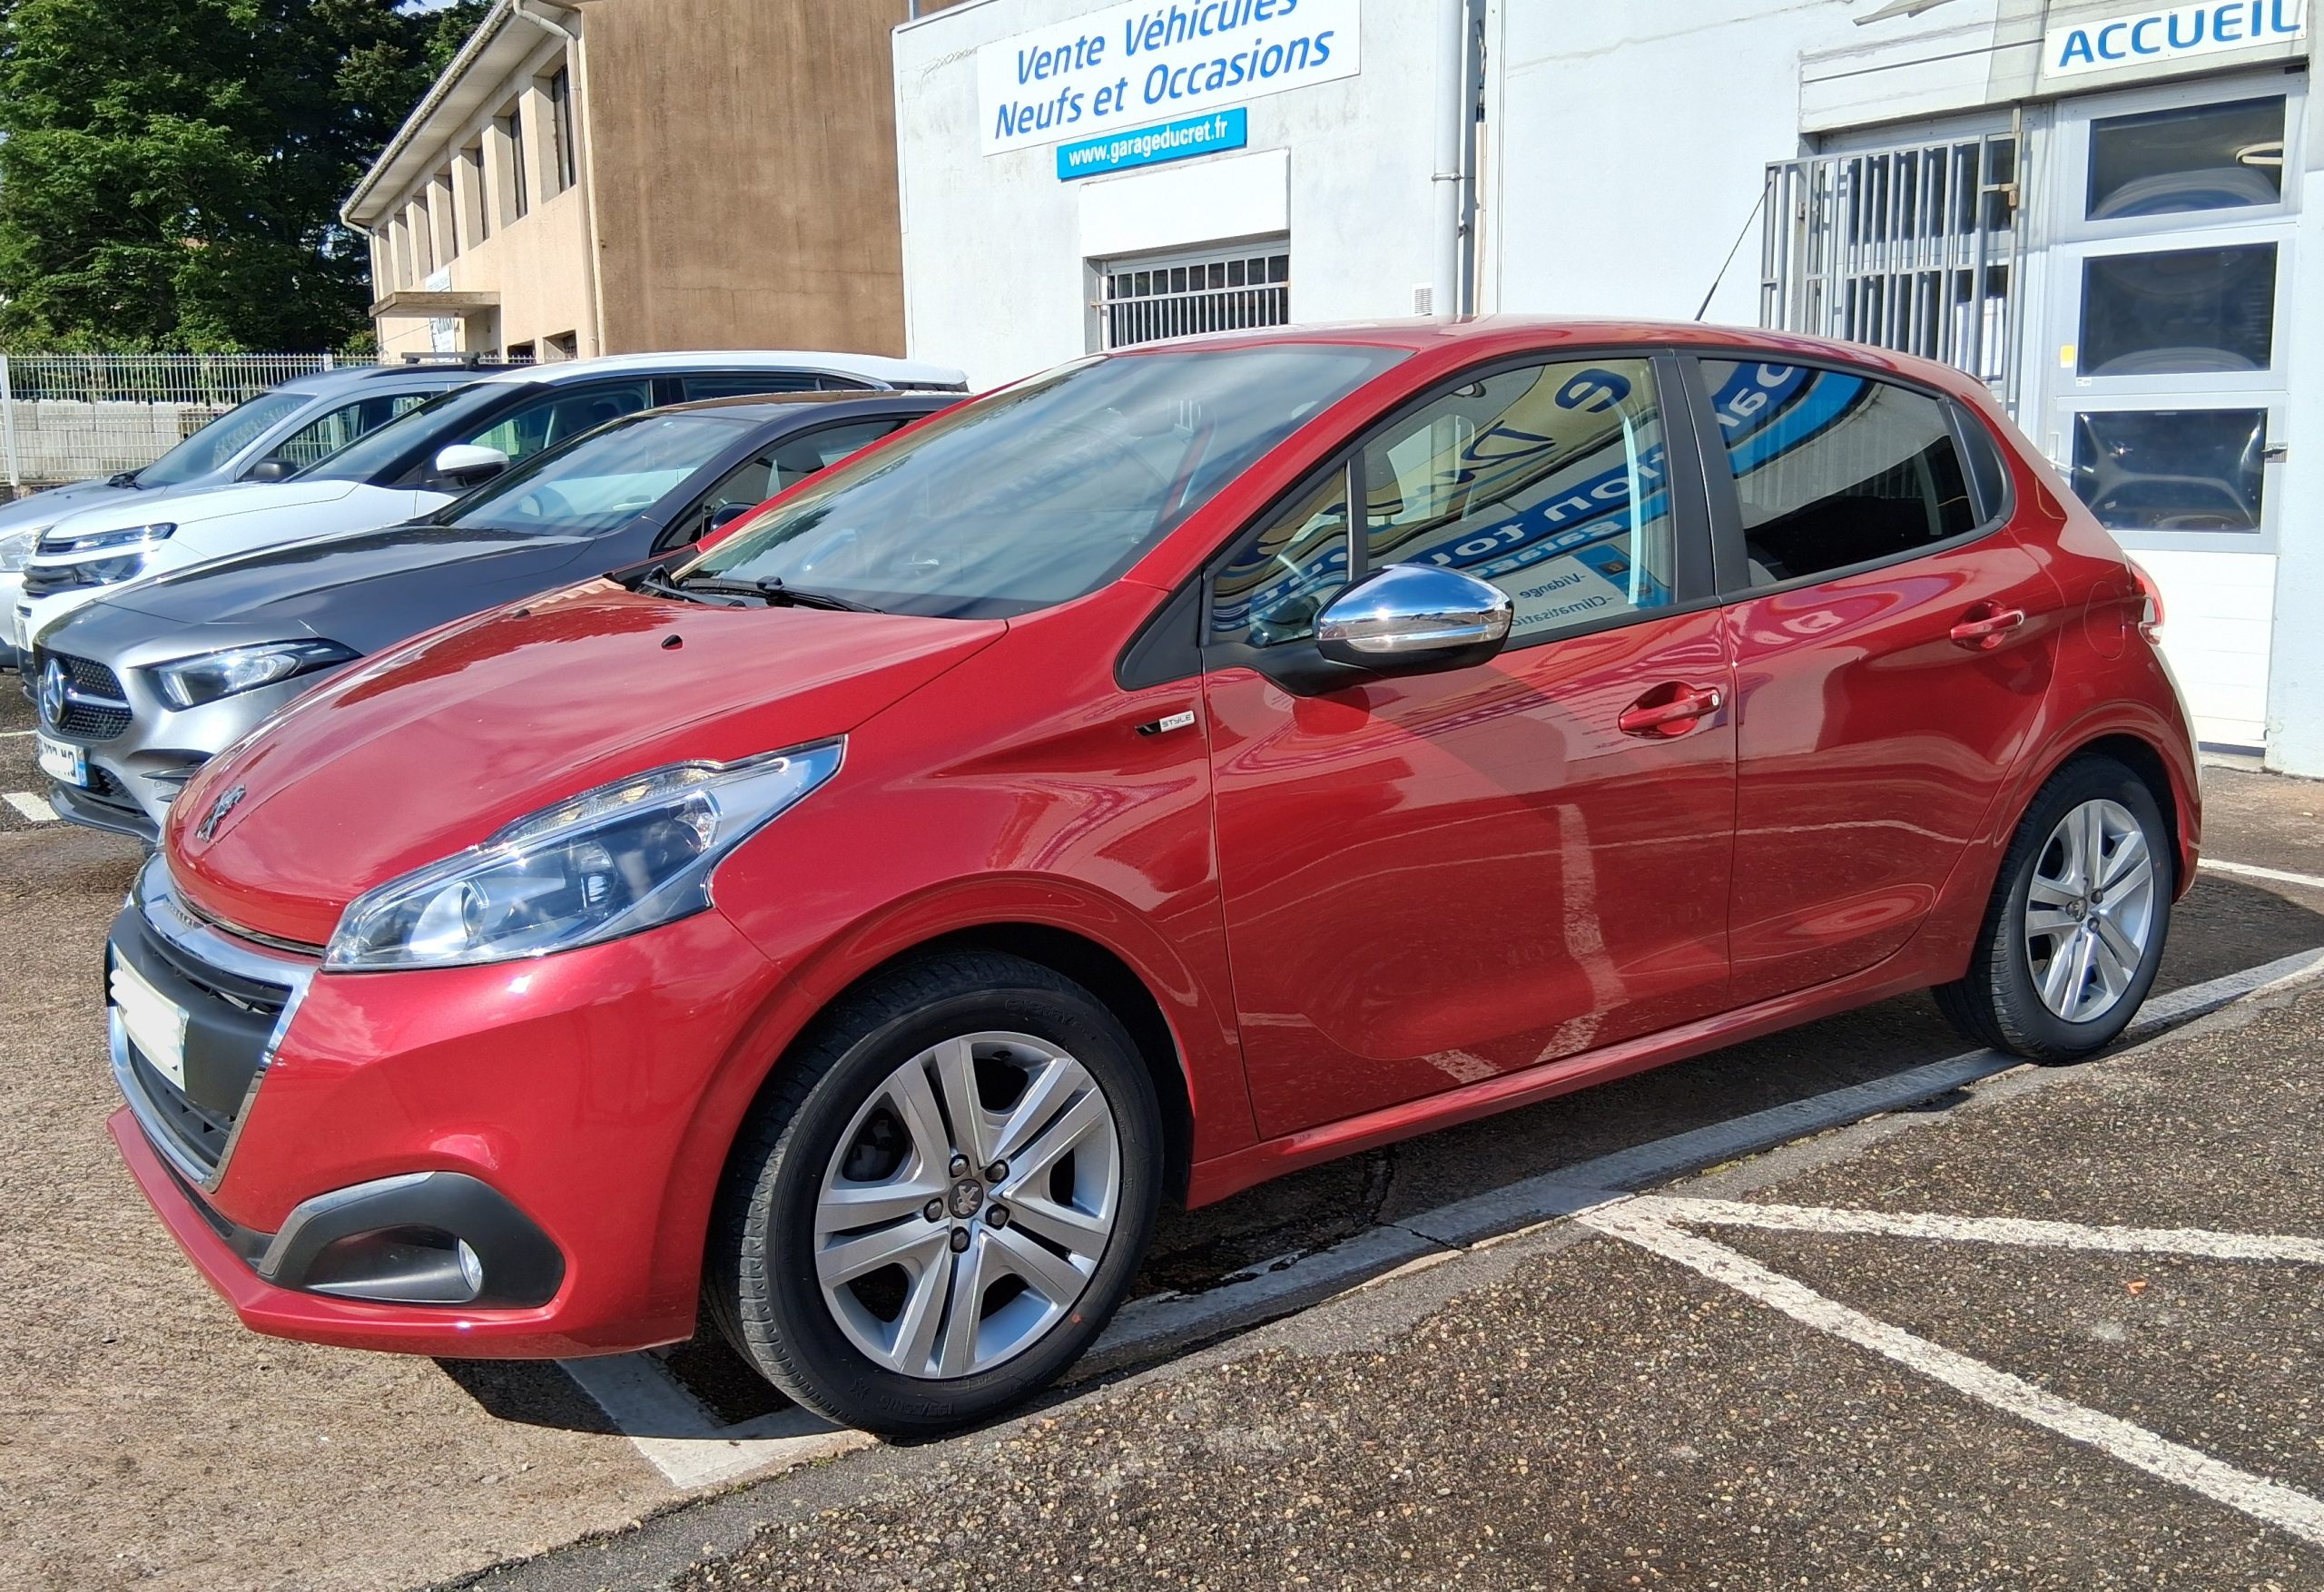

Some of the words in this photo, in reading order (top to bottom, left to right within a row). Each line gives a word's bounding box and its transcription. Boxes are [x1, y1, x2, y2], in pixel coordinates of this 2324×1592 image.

[1017, 33, 1106, 85] Vente
[1125, 0, 1298, 57] Véhicules
[2058, 0, 2301, 67] ACCUEIL
[995, 89, 1082, 140] Neufs
[1093, 77, 1128, 117] et
[1143, 30, 1334, 105] Occasions
[1068, 114, 1227, 167] www.garageducret.fr
[1162, 713, 1192, 728] STYLE
